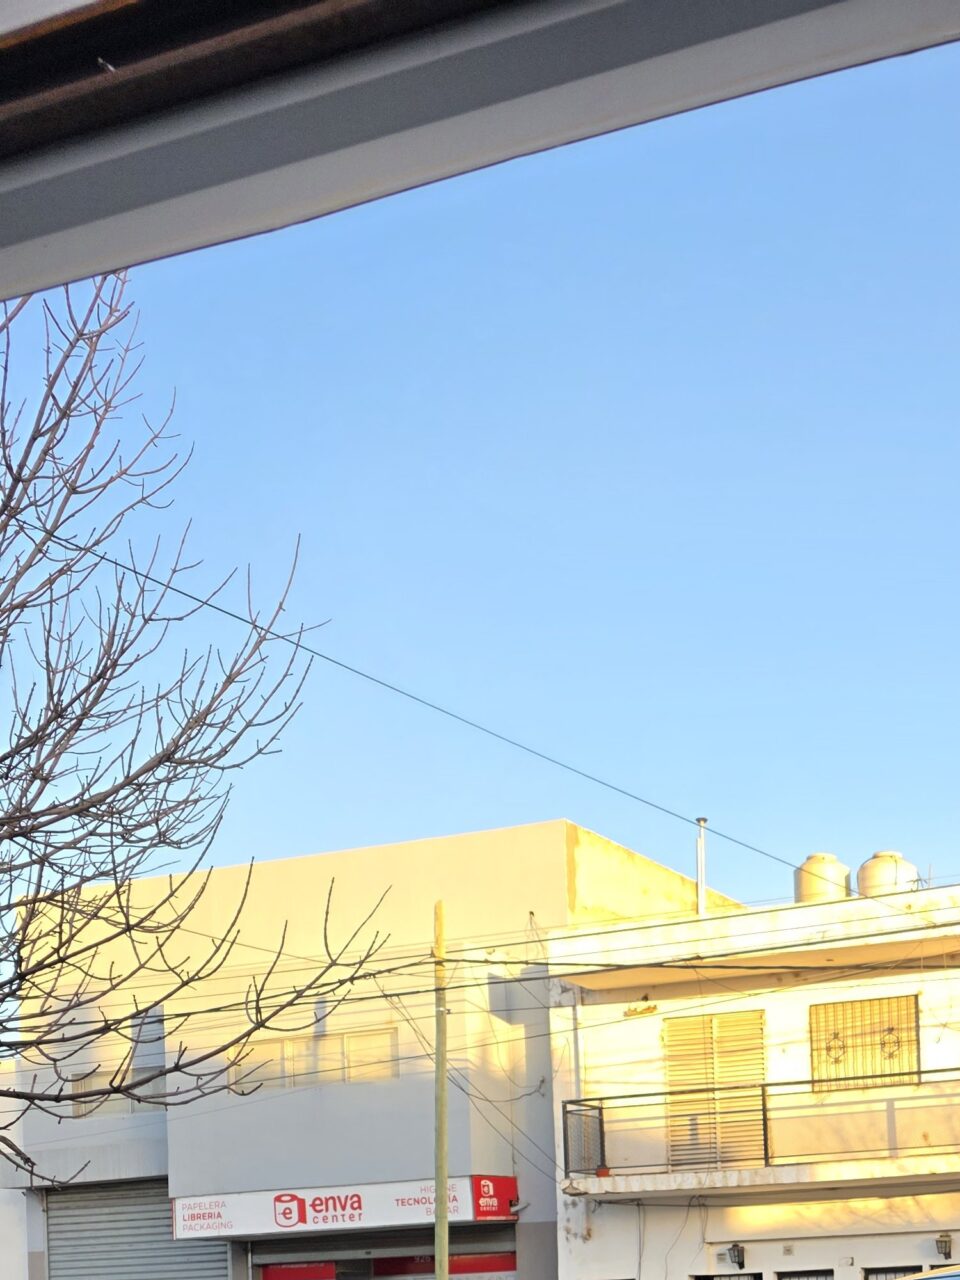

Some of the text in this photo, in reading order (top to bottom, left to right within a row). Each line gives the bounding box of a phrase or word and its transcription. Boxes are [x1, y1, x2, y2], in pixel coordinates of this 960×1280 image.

[309, 1193, 362, 1214] enva
[395, 1193, 458, 1207] TECNOLÍA
[181, 1201, 227, 1211] PAPELERA
[426, 1206, 459, 1216] BAR
[182, 1212, 222, 1222] LIBRERIA
[312, 1212, 363, 1224] center
[182, 1221, 233, 1232] PACKAGING
